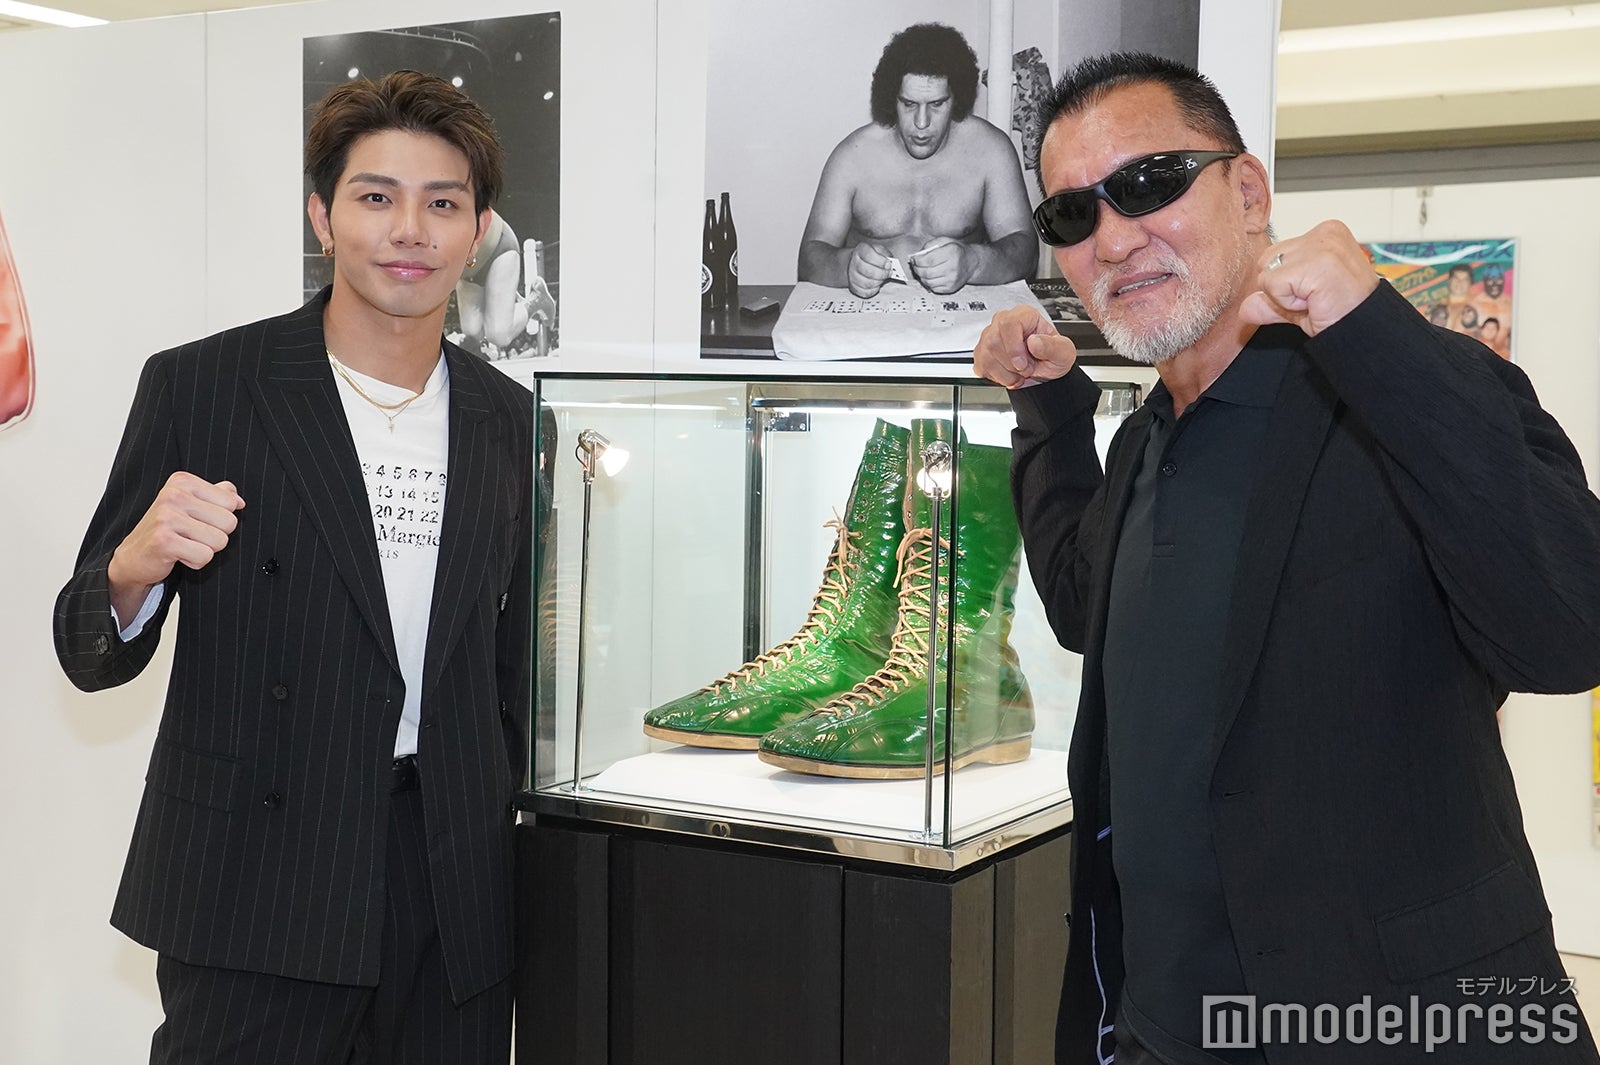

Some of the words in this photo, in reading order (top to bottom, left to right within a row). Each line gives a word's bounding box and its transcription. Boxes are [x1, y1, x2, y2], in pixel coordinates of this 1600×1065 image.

[376, 464, 386, 478] 4
[393, 466, 402, 480] 5
[424, 470, 433, 482] 7
[375, 485, 393, 499] 13
[402, 488, 417, 502] 14
[373, 504, 392, 519] 20
[396, 506, 414, 522] 21
[420, 510, 439, 524] 22
